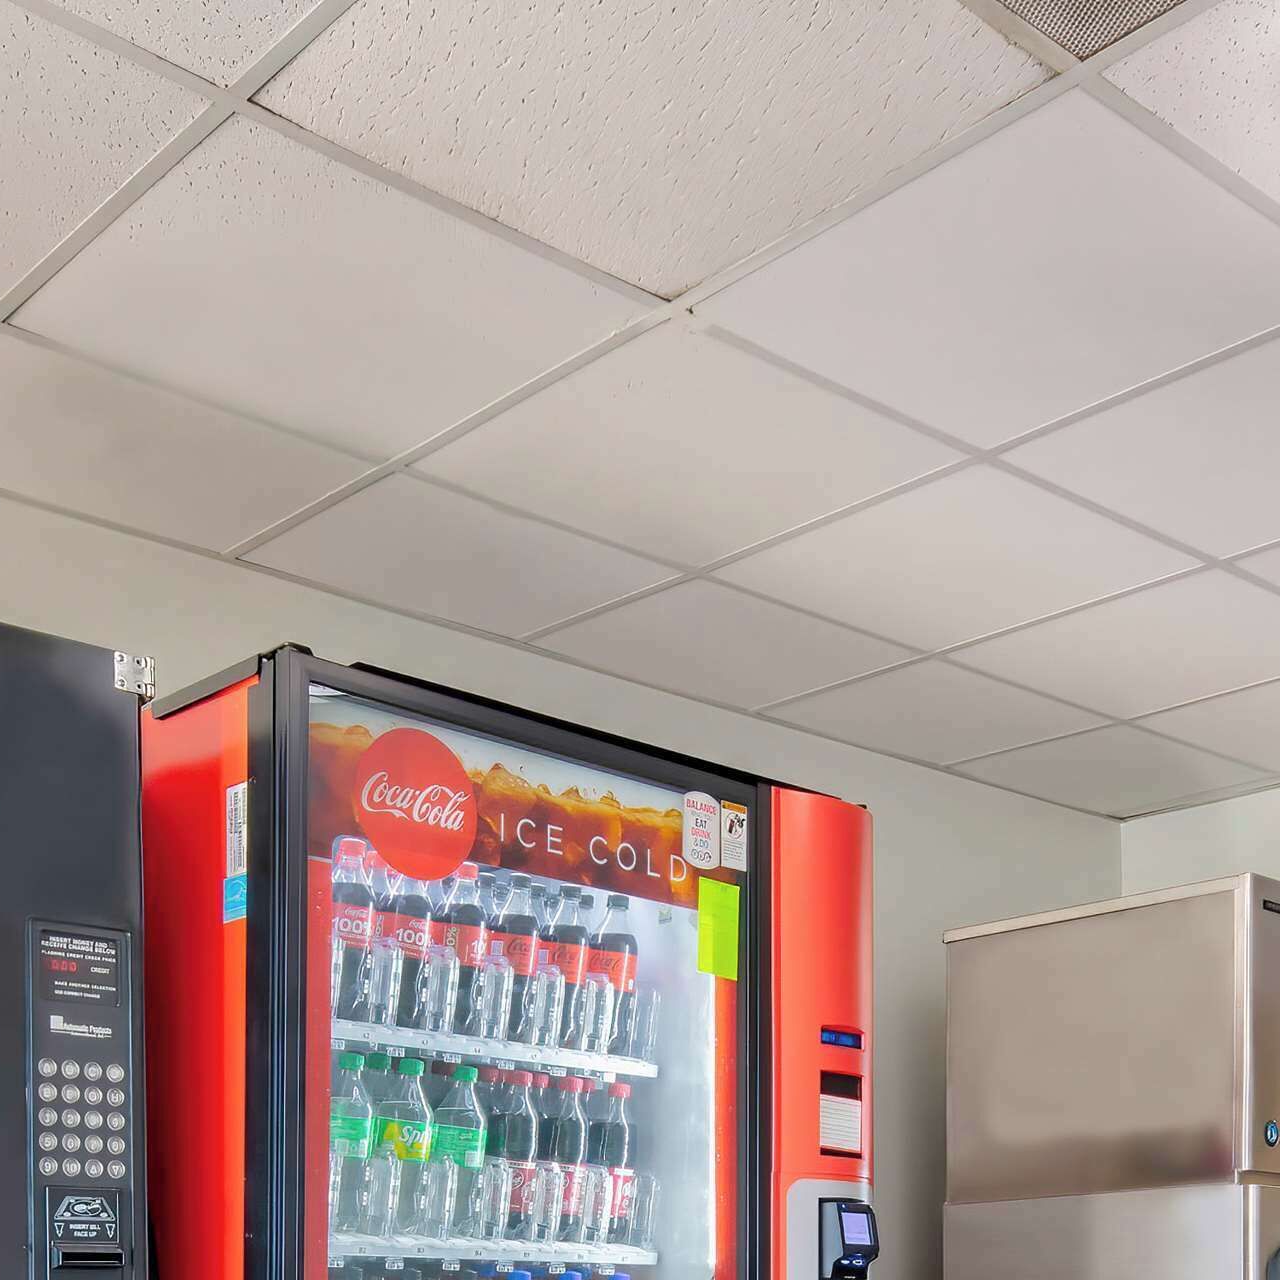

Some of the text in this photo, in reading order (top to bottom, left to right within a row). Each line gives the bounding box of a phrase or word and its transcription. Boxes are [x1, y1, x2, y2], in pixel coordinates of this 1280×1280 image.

[361, 771, 470, 832] Coca-Cola
[686, 798, 718, 815] BALANCE
[695, 818, 707, 829] EAT
[690, 827, 711, 840] DRINK
[500, 813, 564, 855] ICE
[588, 835, 687, 882] COLD
[395, 927, 428, 946] 100
